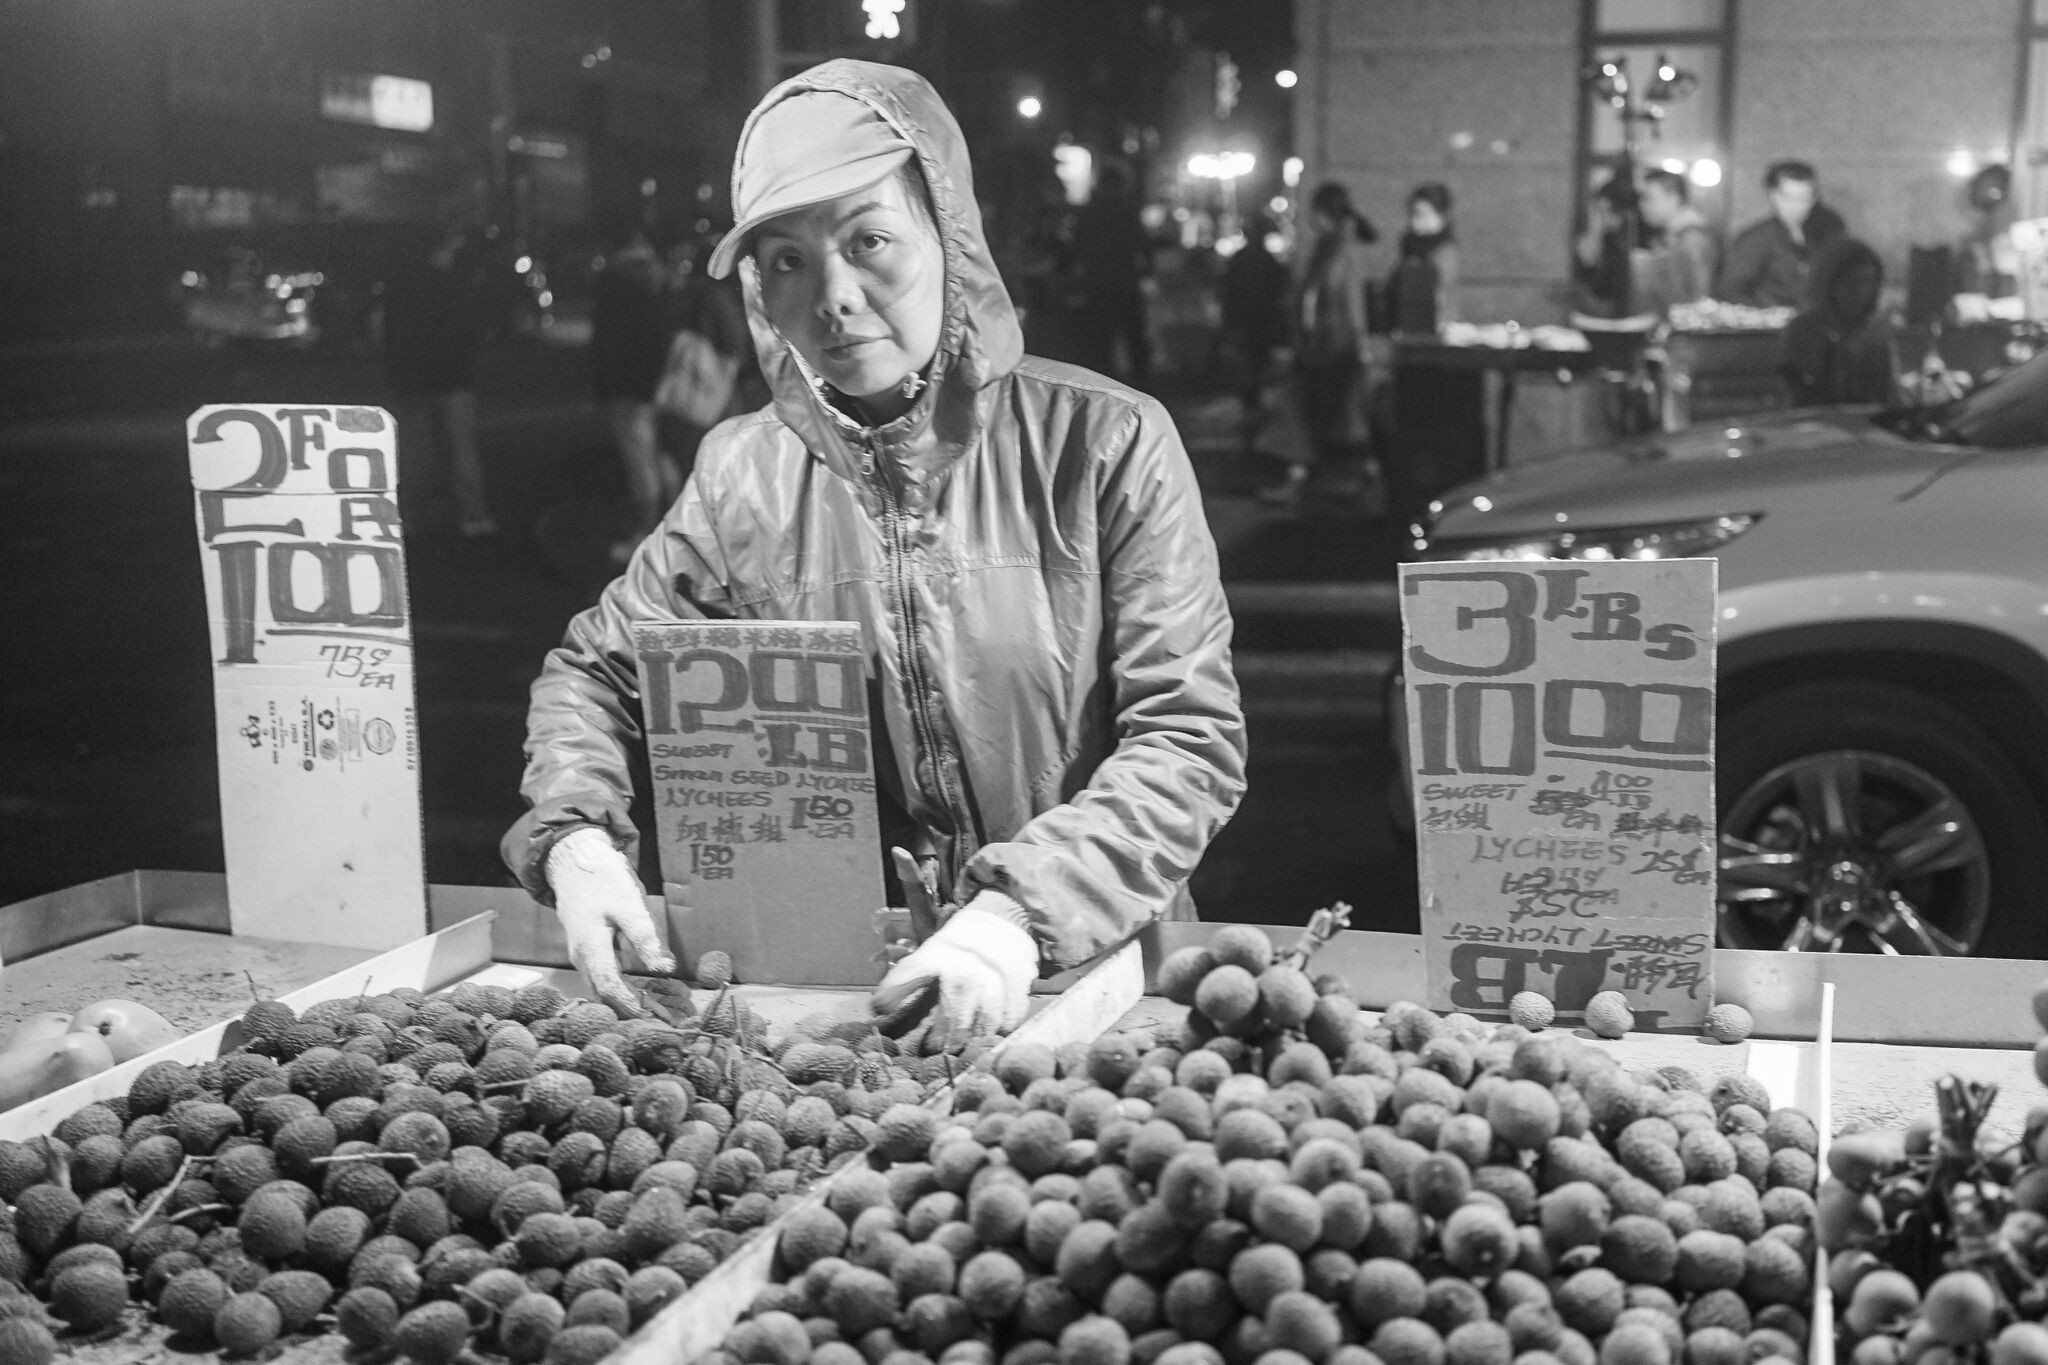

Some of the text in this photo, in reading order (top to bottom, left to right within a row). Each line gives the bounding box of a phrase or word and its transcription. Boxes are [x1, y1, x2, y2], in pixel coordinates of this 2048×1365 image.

[191, 408, 306, 543] 2
[1403, 568, 1698, 678] 3 LBS
[358, 671, 396, 691] EA
[730, 769, 791, 787] SEED
[663, 787, 773, 808] LYCHEES
[1421, 783, 1530, 801] SWEET
[1469, 834, 1631, 866] LYCHEES
